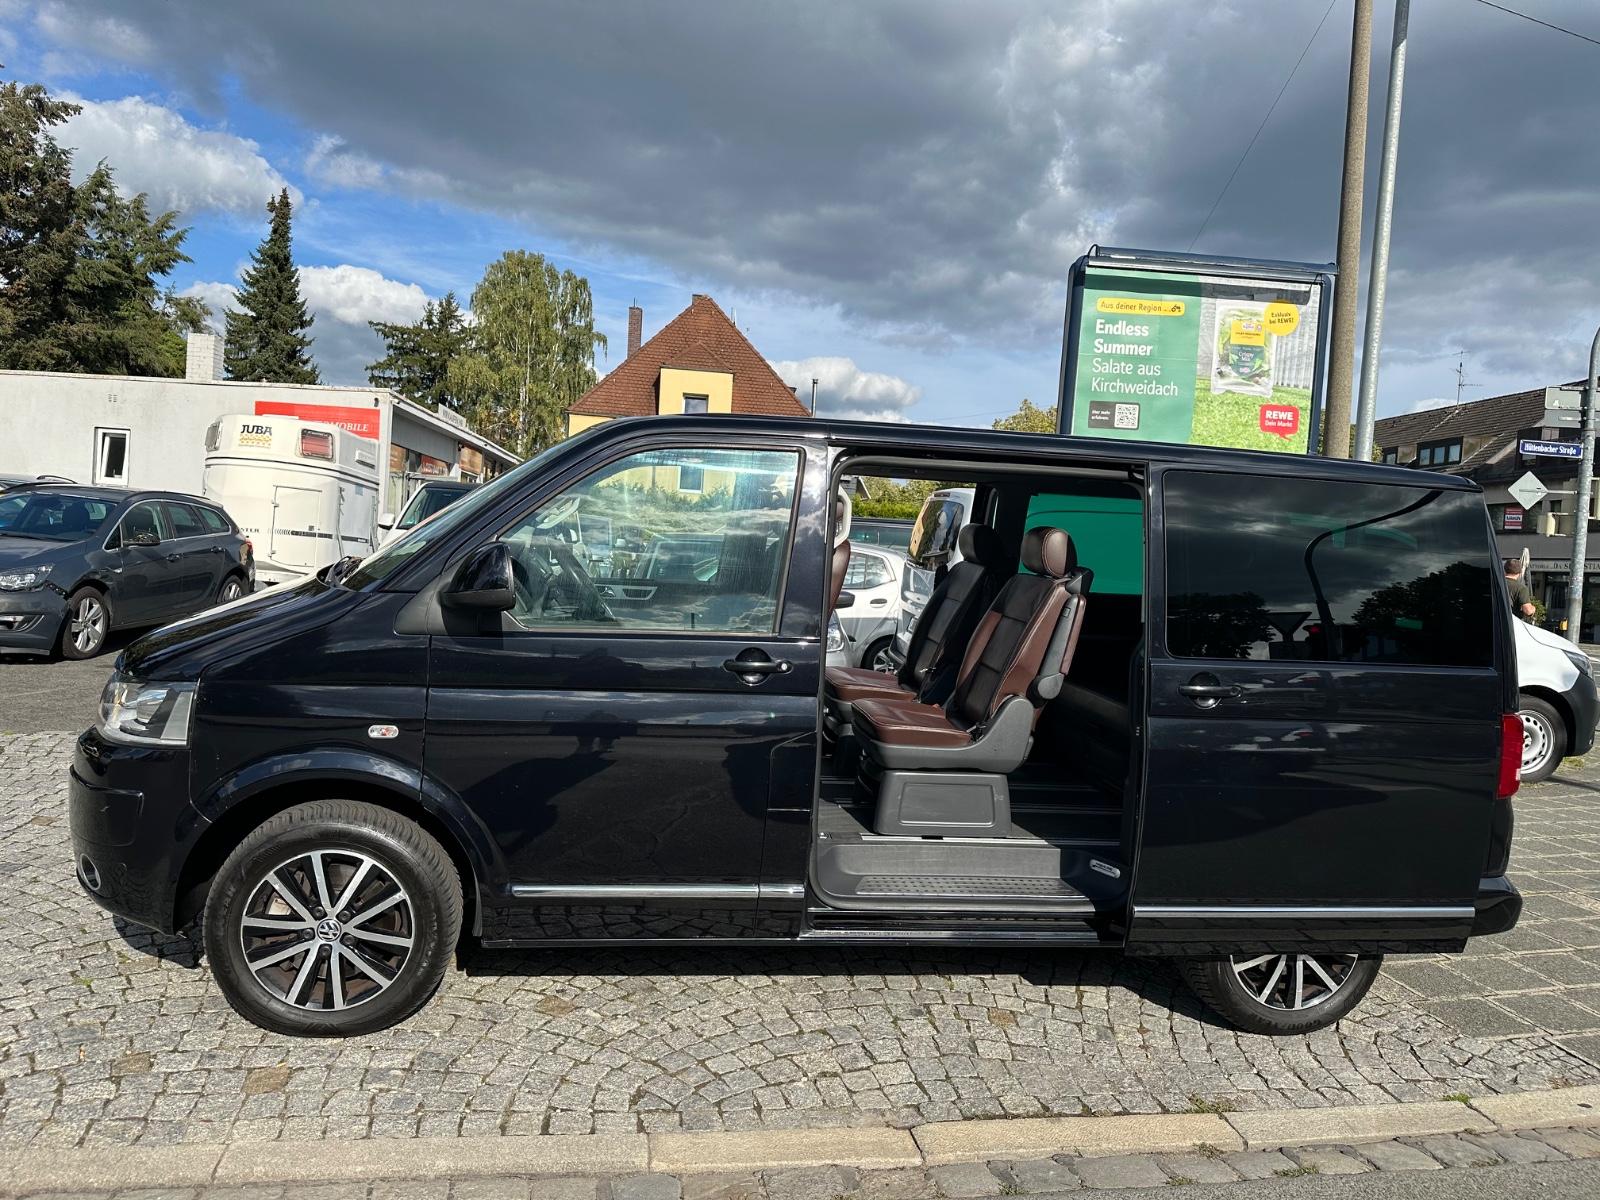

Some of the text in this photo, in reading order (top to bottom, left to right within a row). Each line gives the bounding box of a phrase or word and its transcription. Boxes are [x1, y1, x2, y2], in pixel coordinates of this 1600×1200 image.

[1100, 301, 1162, 314] Aus deiner Region
[1095, 318, 1149, 336] Endless
[1093, 338, 1153, 356] Summer
[1092, 357, 1161, 376] Salate aus
[1091, 377, 1178, 396] Kirchweidach
[1265, 410, 1294, 421] REWE
[240, 424, 272, 436] JUBA
[1558, 445, 1577, 456] Straße
